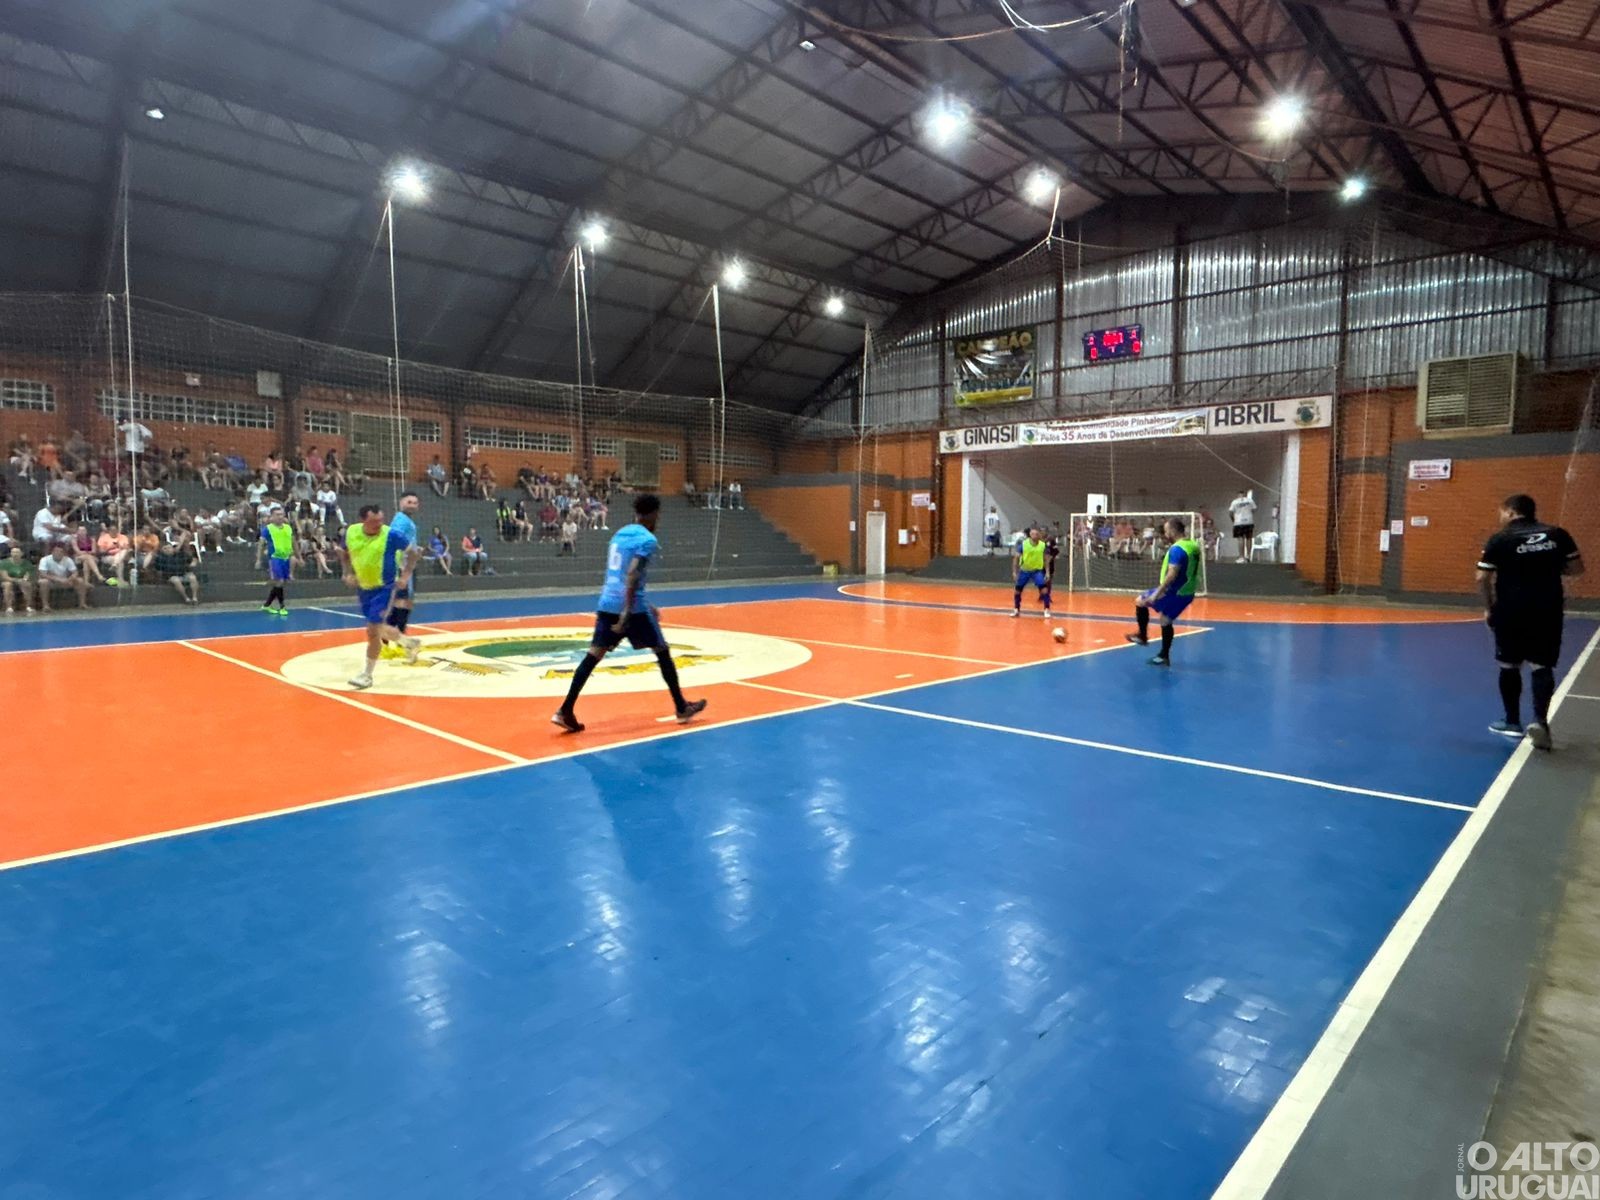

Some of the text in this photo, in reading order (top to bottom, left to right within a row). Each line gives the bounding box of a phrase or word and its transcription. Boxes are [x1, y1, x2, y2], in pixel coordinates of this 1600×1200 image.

[1214, 402, 1285, 427] ABRIL
[1061, 430, 1075, 441] 35
[1076, 431, 1096, 441] Anos
